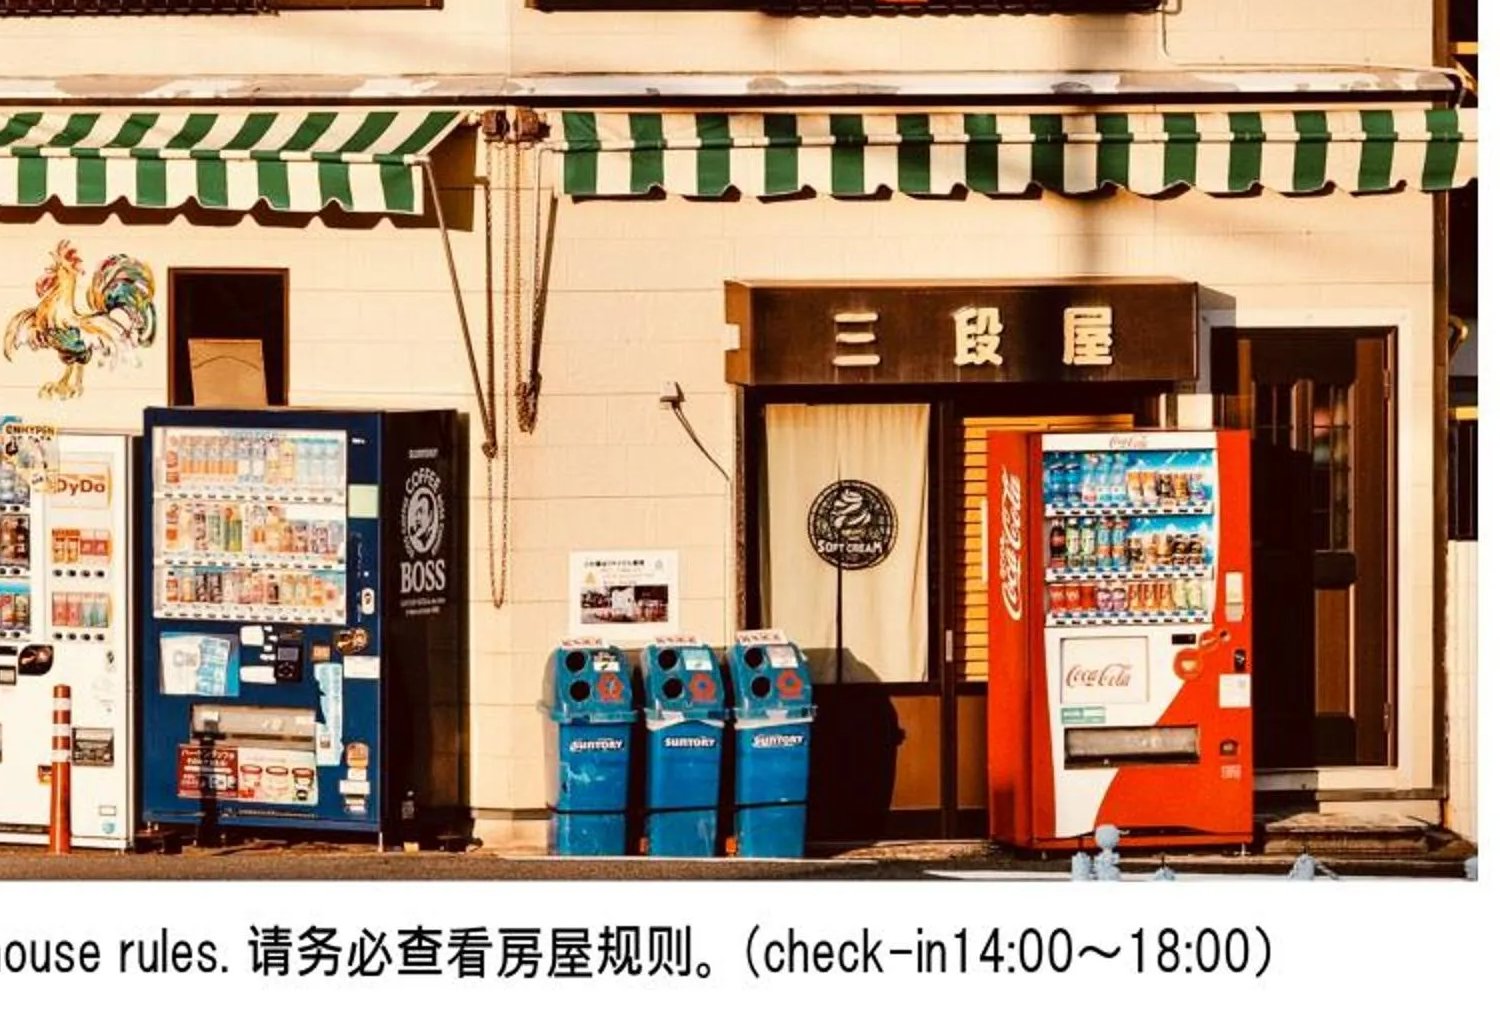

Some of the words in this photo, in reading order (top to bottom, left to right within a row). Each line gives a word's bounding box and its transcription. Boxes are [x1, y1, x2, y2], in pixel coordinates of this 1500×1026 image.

[833, 306, 1113, 367] 三段屋
[401, 559, 446, 593] BOSS
